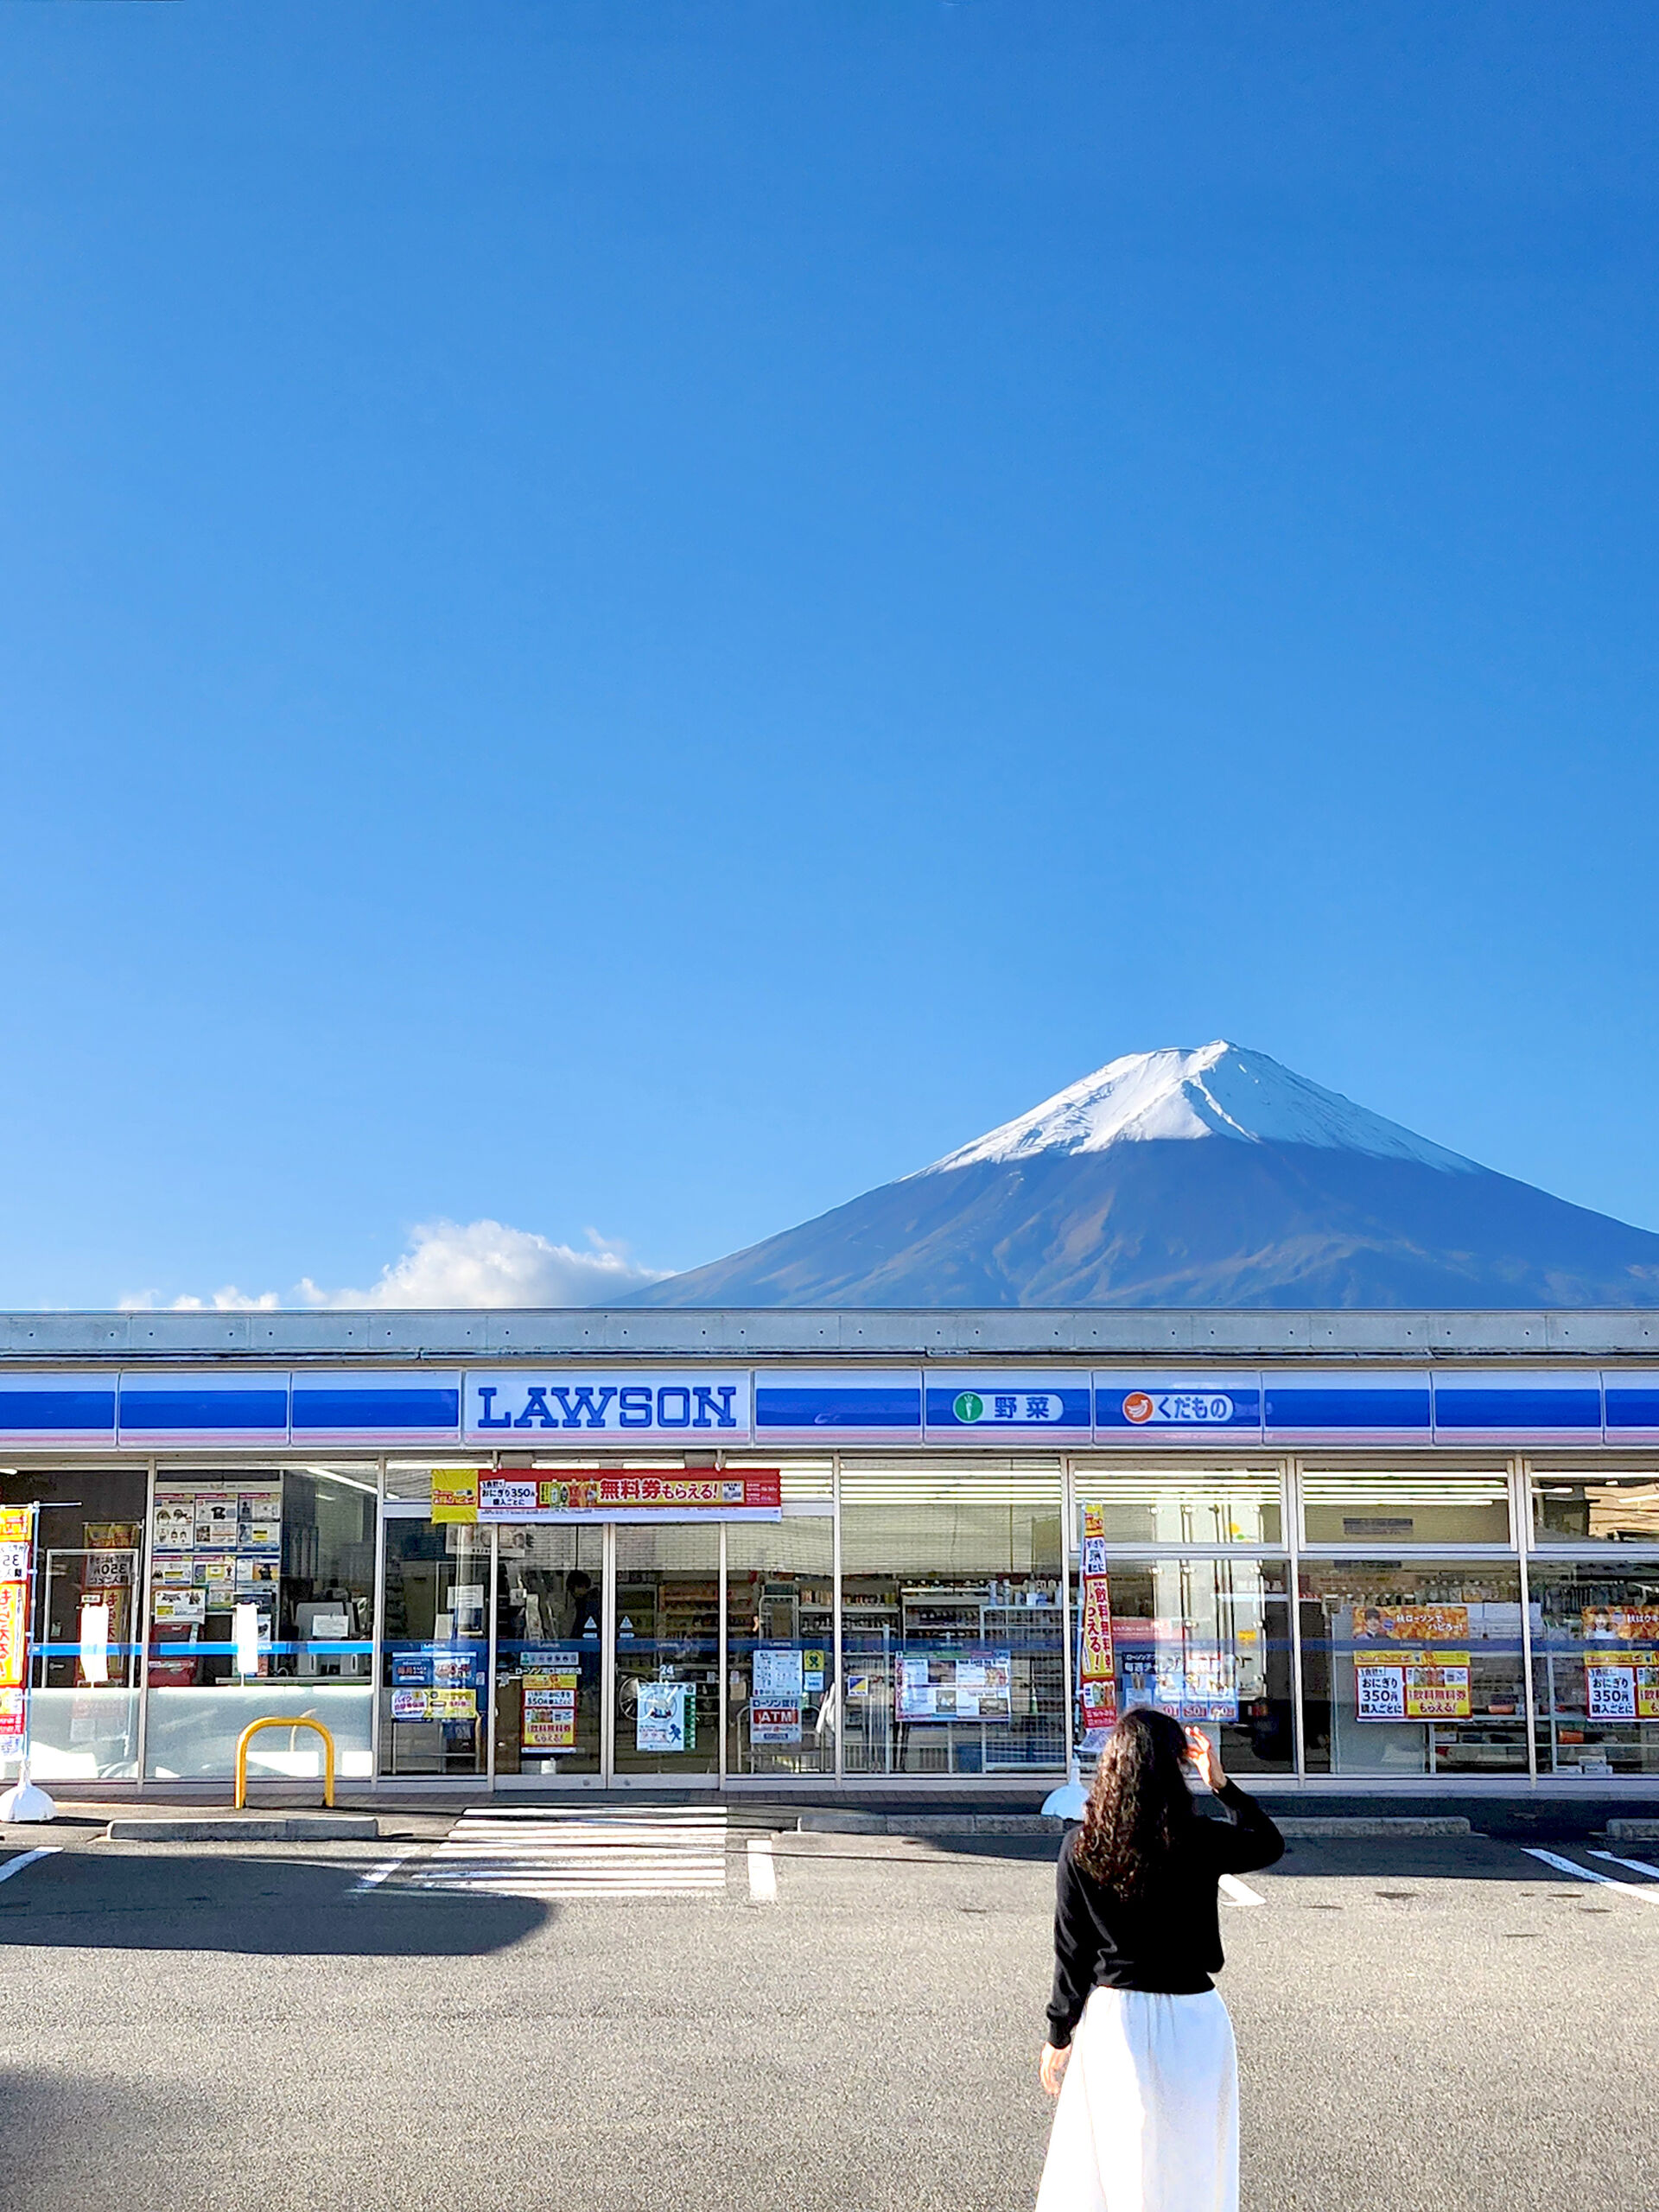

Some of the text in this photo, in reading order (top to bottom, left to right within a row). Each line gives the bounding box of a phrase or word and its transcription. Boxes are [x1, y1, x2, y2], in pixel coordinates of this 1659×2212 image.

[478, 1387, 736, 1427] LAWSON
[995, 1396, 1049, 1419] 野菜
[1157, 1396, 1227, 1419] くだもの
[600, 1478, 718, 1500] 無料券もらえる!
[659, 1664, 675, 1675] 24
[1362, 1678, 1398, 1688] おにぎり
[760, 1712, 792, 1722] ATM
